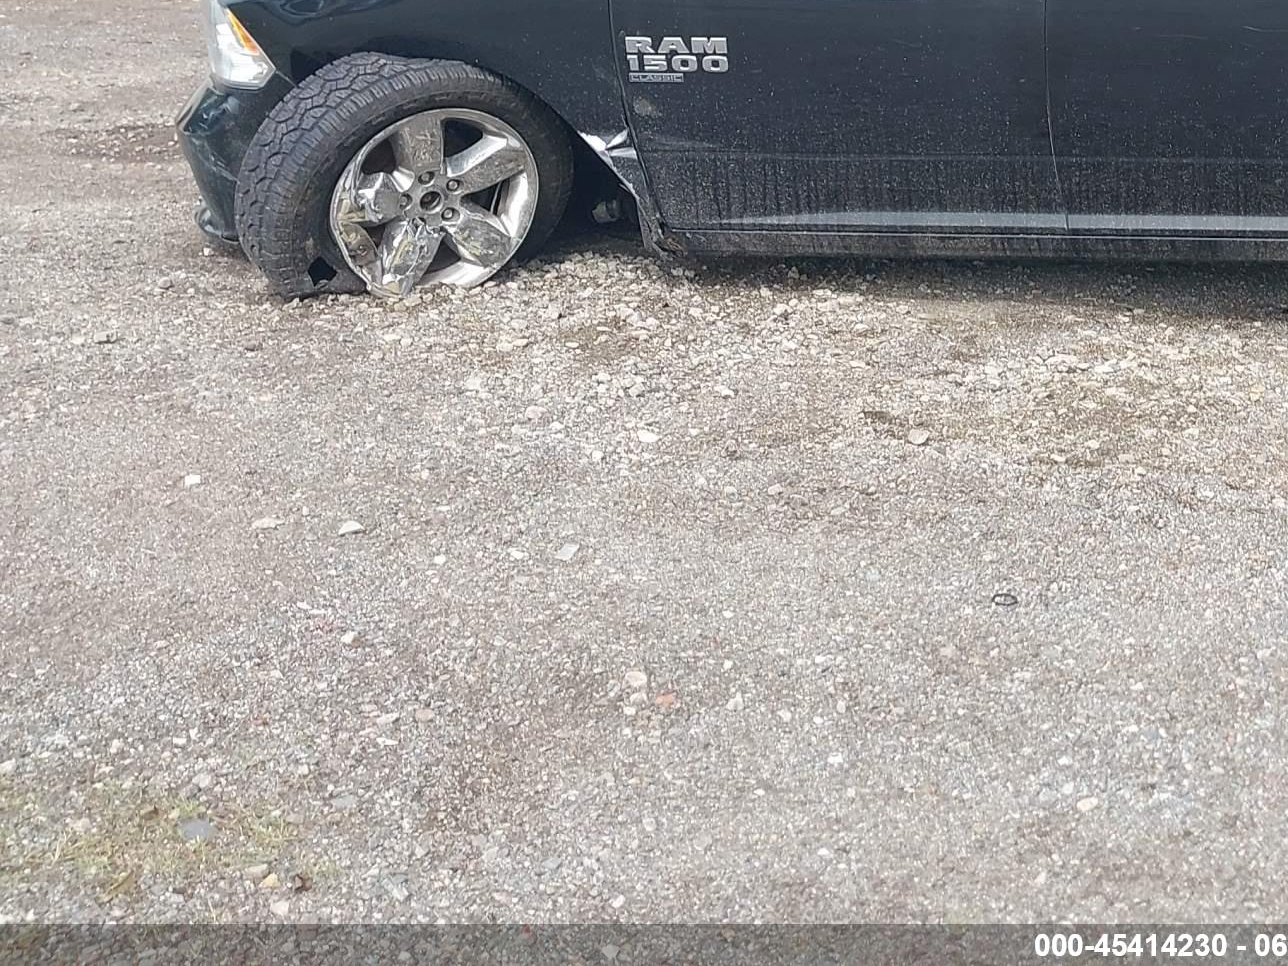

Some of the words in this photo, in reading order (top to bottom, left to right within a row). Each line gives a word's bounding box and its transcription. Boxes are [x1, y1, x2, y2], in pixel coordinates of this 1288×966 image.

[625, 36, 728, 54] RAM
[626, 54, 729, 72] 1500
[629, 73, 684, 83] CLASSIC
